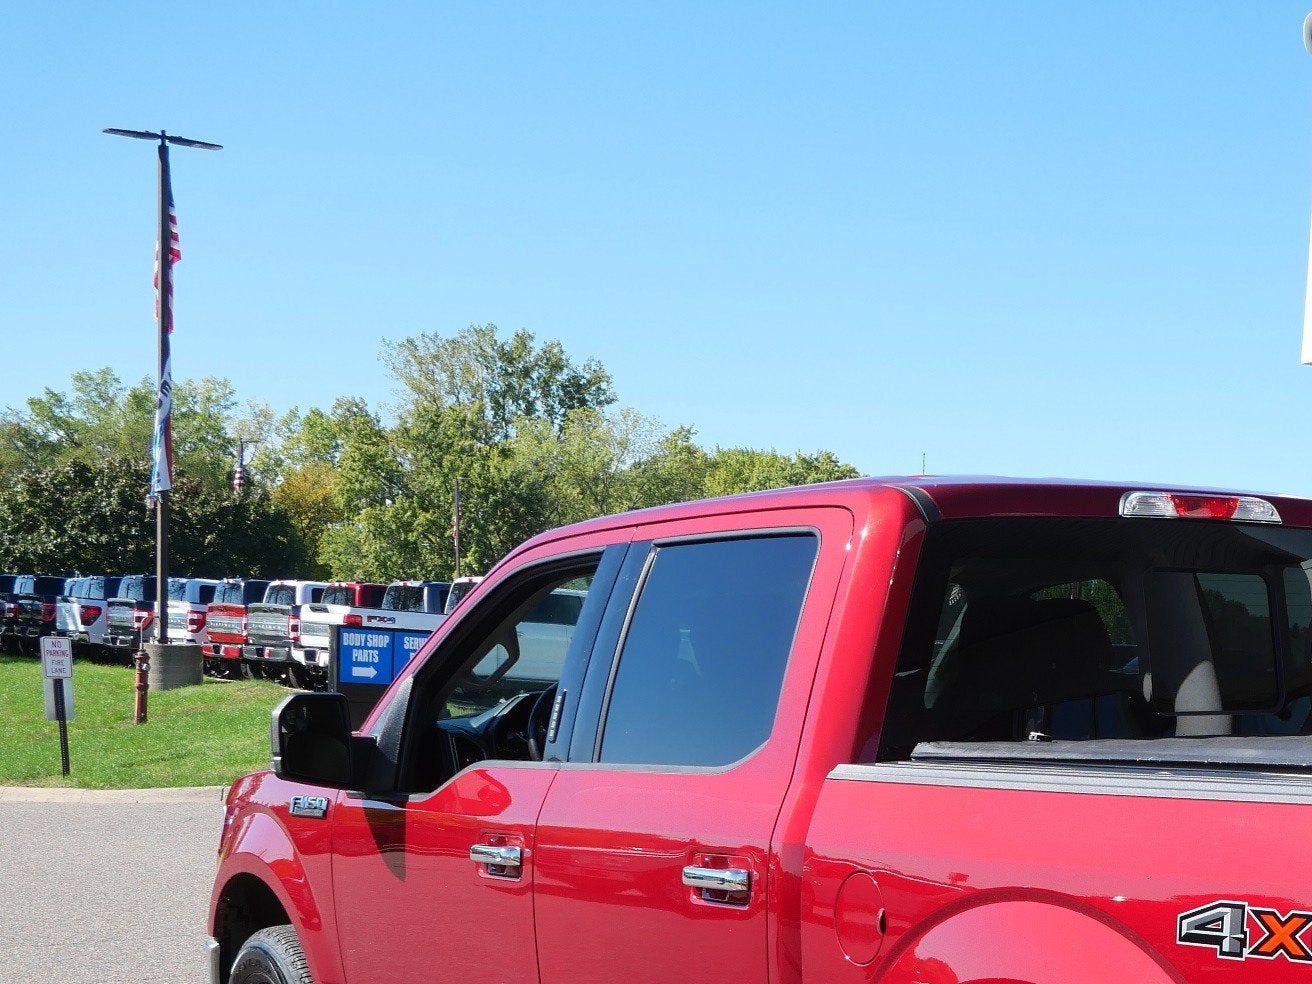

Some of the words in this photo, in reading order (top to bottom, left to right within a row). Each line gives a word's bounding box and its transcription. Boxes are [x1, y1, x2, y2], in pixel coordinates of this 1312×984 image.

[366, 615, 396, 624] FX4
[51, 640, 62, 649] NO
[343, 632, 366, 646] BODY
[367, 634, 389, 648] SHOP
[403, 636, 428, 650] SERV
[45, 649, 69, 658] PARKING
[352, 649, 379, 663] PARTS
